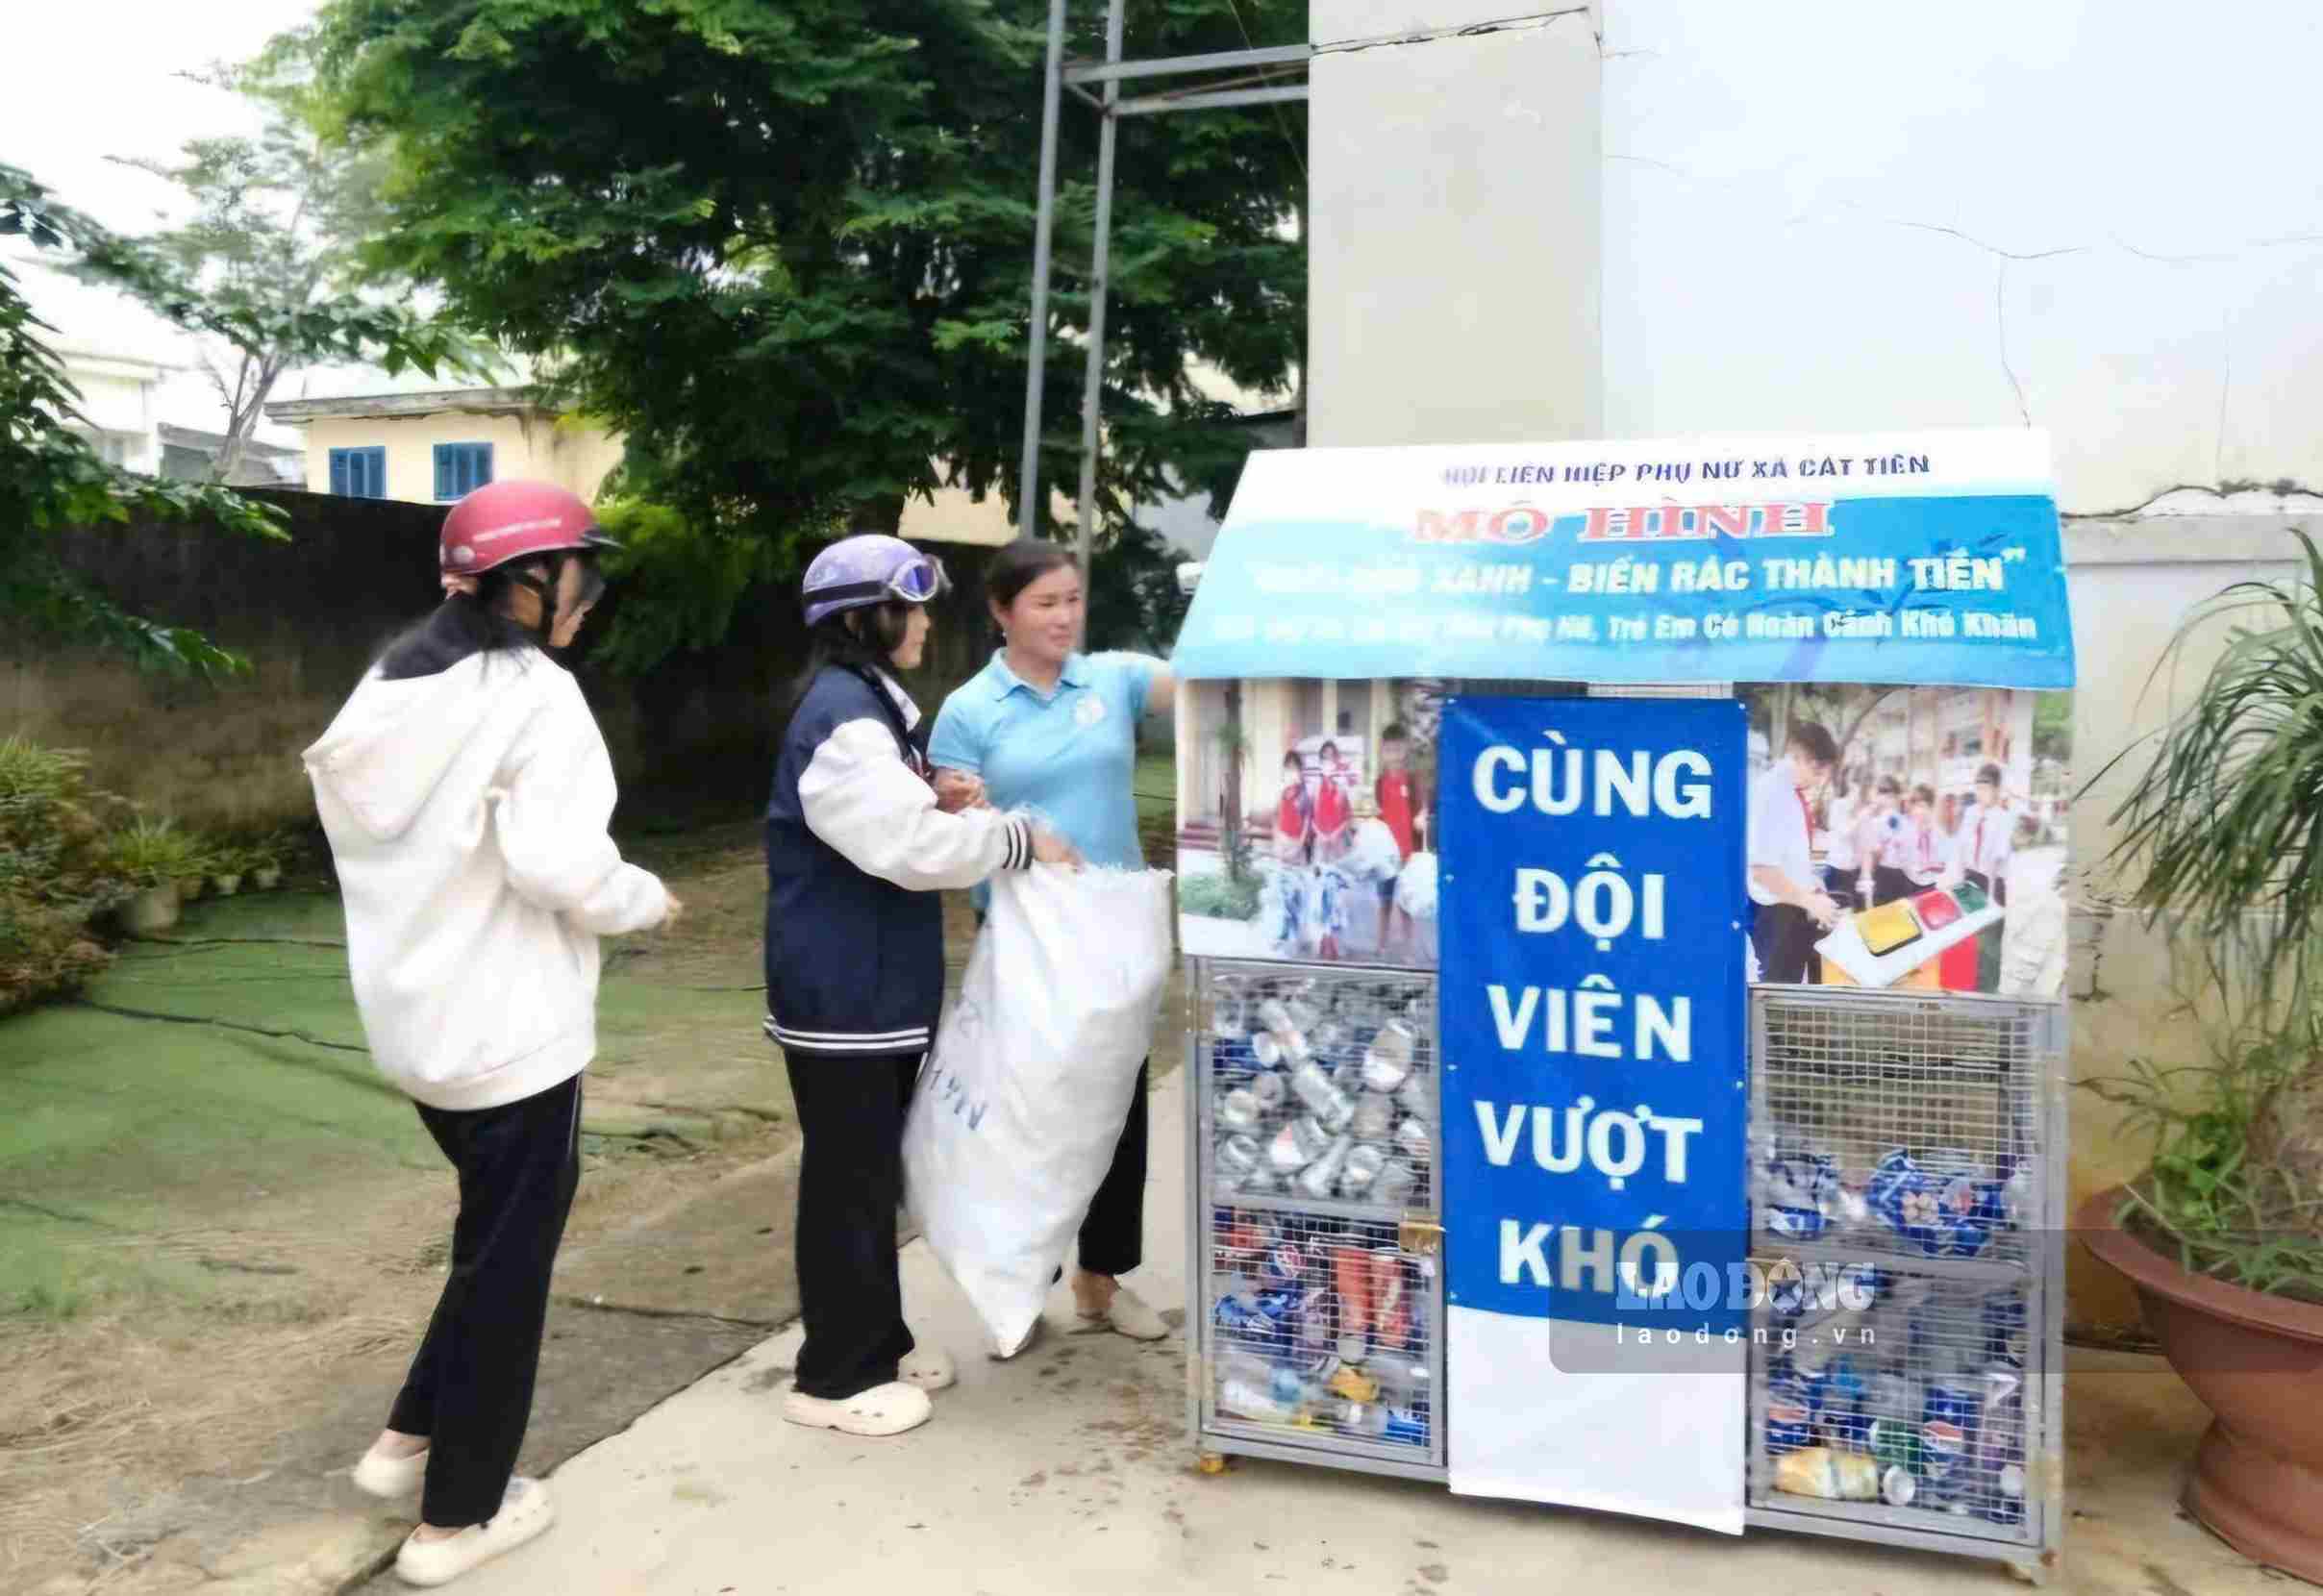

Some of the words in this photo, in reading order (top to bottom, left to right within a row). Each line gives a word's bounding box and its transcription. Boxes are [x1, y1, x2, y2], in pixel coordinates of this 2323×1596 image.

[1567, 554, 1659, 593] BIẾN
[1671, 554, 1750, 591] RÁC
[1473, 730, 1712, 819] CÙNG
[1512, 852, 1664, 952] ĐỘI
[1486, 973, 1690, 1062] VIÊN
[1473, 1096, 1703, 1191] VƯỢT
[1499, 1214, 1679, 1298] KHÓ
